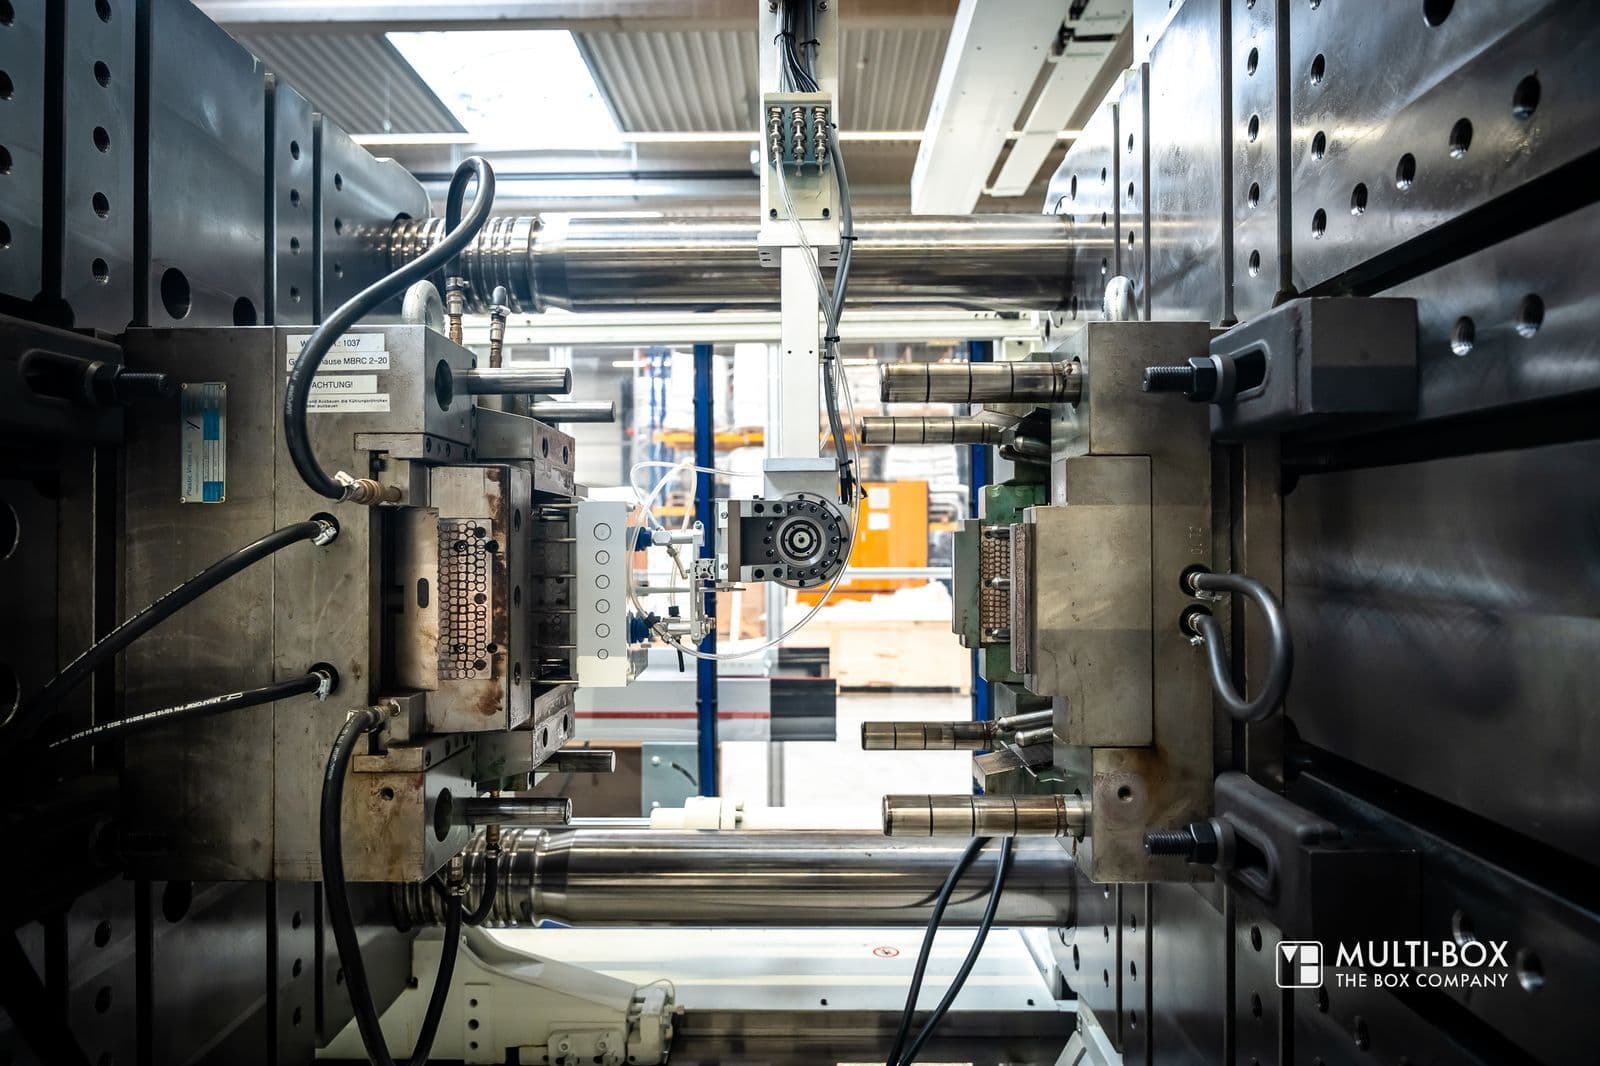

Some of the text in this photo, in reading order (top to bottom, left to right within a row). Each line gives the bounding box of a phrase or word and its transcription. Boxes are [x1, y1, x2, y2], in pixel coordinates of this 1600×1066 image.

[343, 339, 360, 347] 1037
[343, 357, 367, 365] MBRC
[368, 357, 388, 365] 2-20
[311, 380, 353, 389] ACHTUNG!
